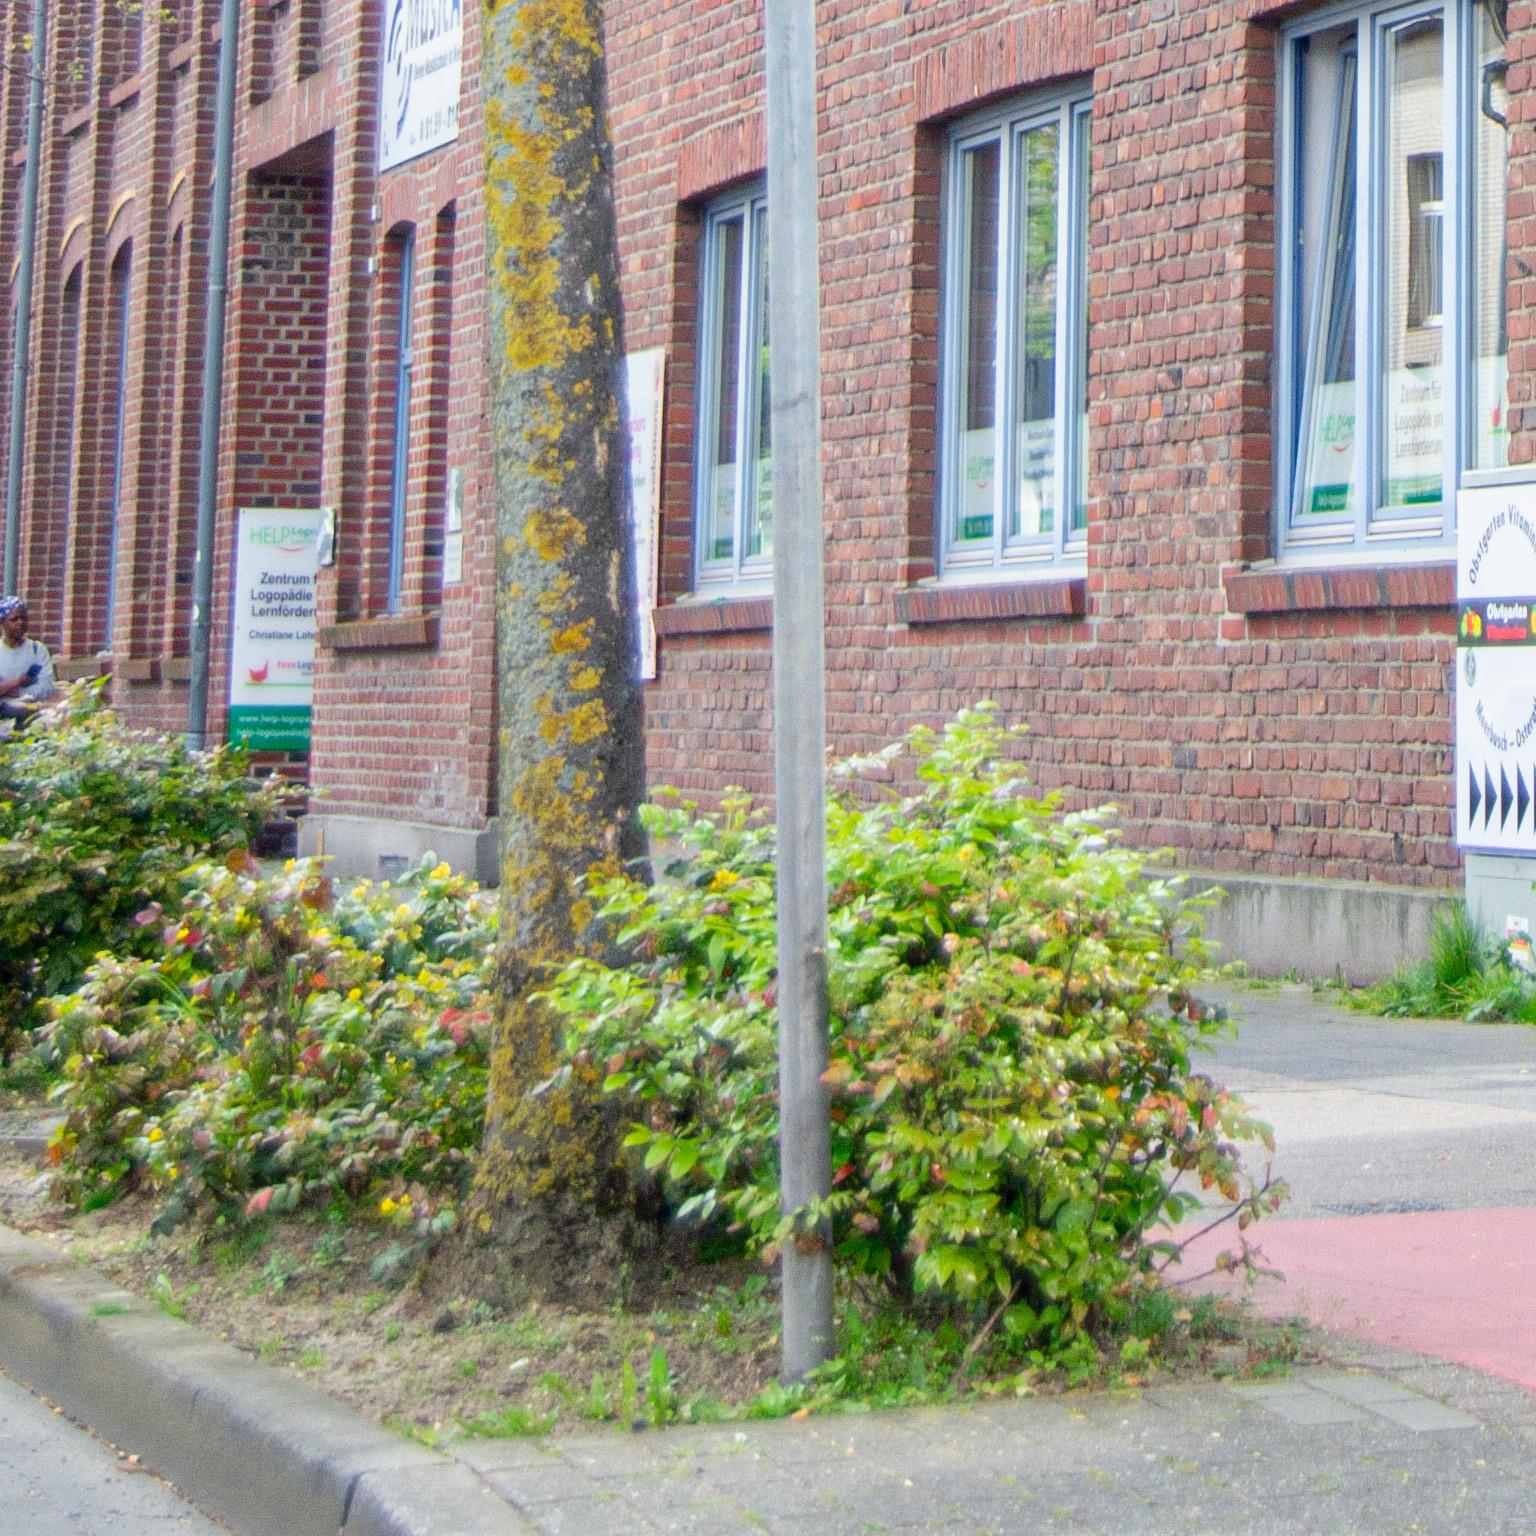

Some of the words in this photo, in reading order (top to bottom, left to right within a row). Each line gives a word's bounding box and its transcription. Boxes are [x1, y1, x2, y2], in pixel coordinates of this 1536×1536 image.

[249, 527, 290, 545] HELP
[1469, 512, 1506, 585] Obstgarten
[260, 572, 310, 585] Zentrum
[251, 588, 313, 604] Logopädie
[1475, 698, 1508, 752] Meerbusch
